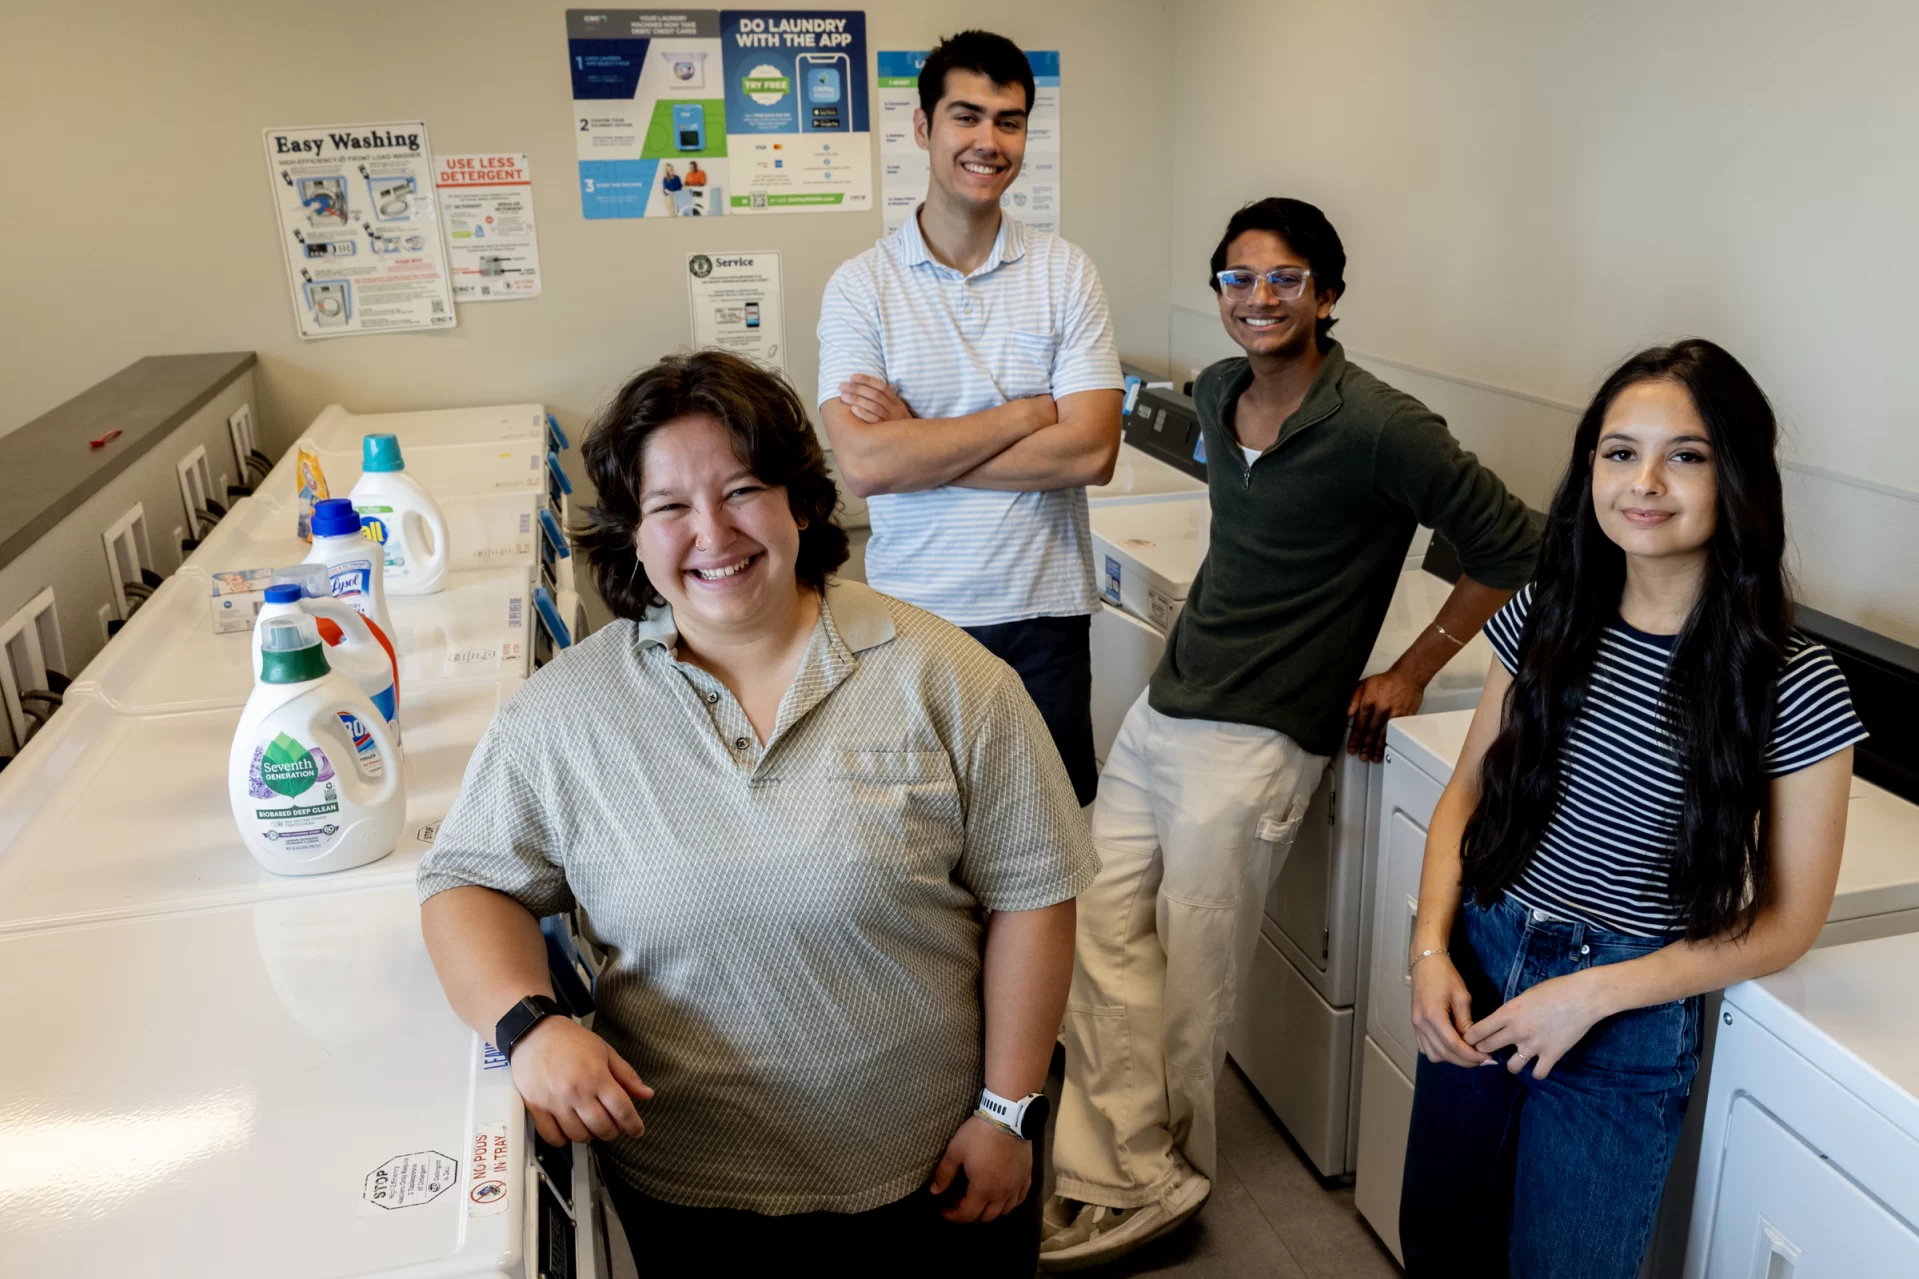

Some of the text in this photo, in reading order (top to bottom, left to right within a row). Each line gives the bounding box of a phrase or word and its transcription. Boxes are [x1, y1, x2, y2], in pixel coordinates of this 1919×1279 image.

[740, 18, 846, 33] DO LAUNDRY
[736, 33, 852, 47] WITH THE APP
[576, 55, 583, 70] 1
[745, 81, 787, 90] TRY FREE
[580, 118, 589, 131] 2
[275, 130, 420, 157] Easy Washing
[446, 157, 515, 169] USE LESS
[440, 169, 523, 181] DETERGENT
[584, 179, 595, 192] 3
[716, 257, 754, 267] Service
[361, 521, 383, 542] all
[332, 573, 359, 593] Lysol
[360, 753, 376, 762] rmula
[264, 758, 312, 773] Seventh
[266, 769, 314, 781] GENERATION
[259, 804, 336, 818] BIOBASED DEEP CLEAN
[423, 826, 434, 840] STOP
[473, 1134, 488, 1180] NO PODS
[493, 1135, 508, 1173] IN TRAY
[373, 1169, 388, 1199] STOP
[399, 1174, 408, 1185] Only
